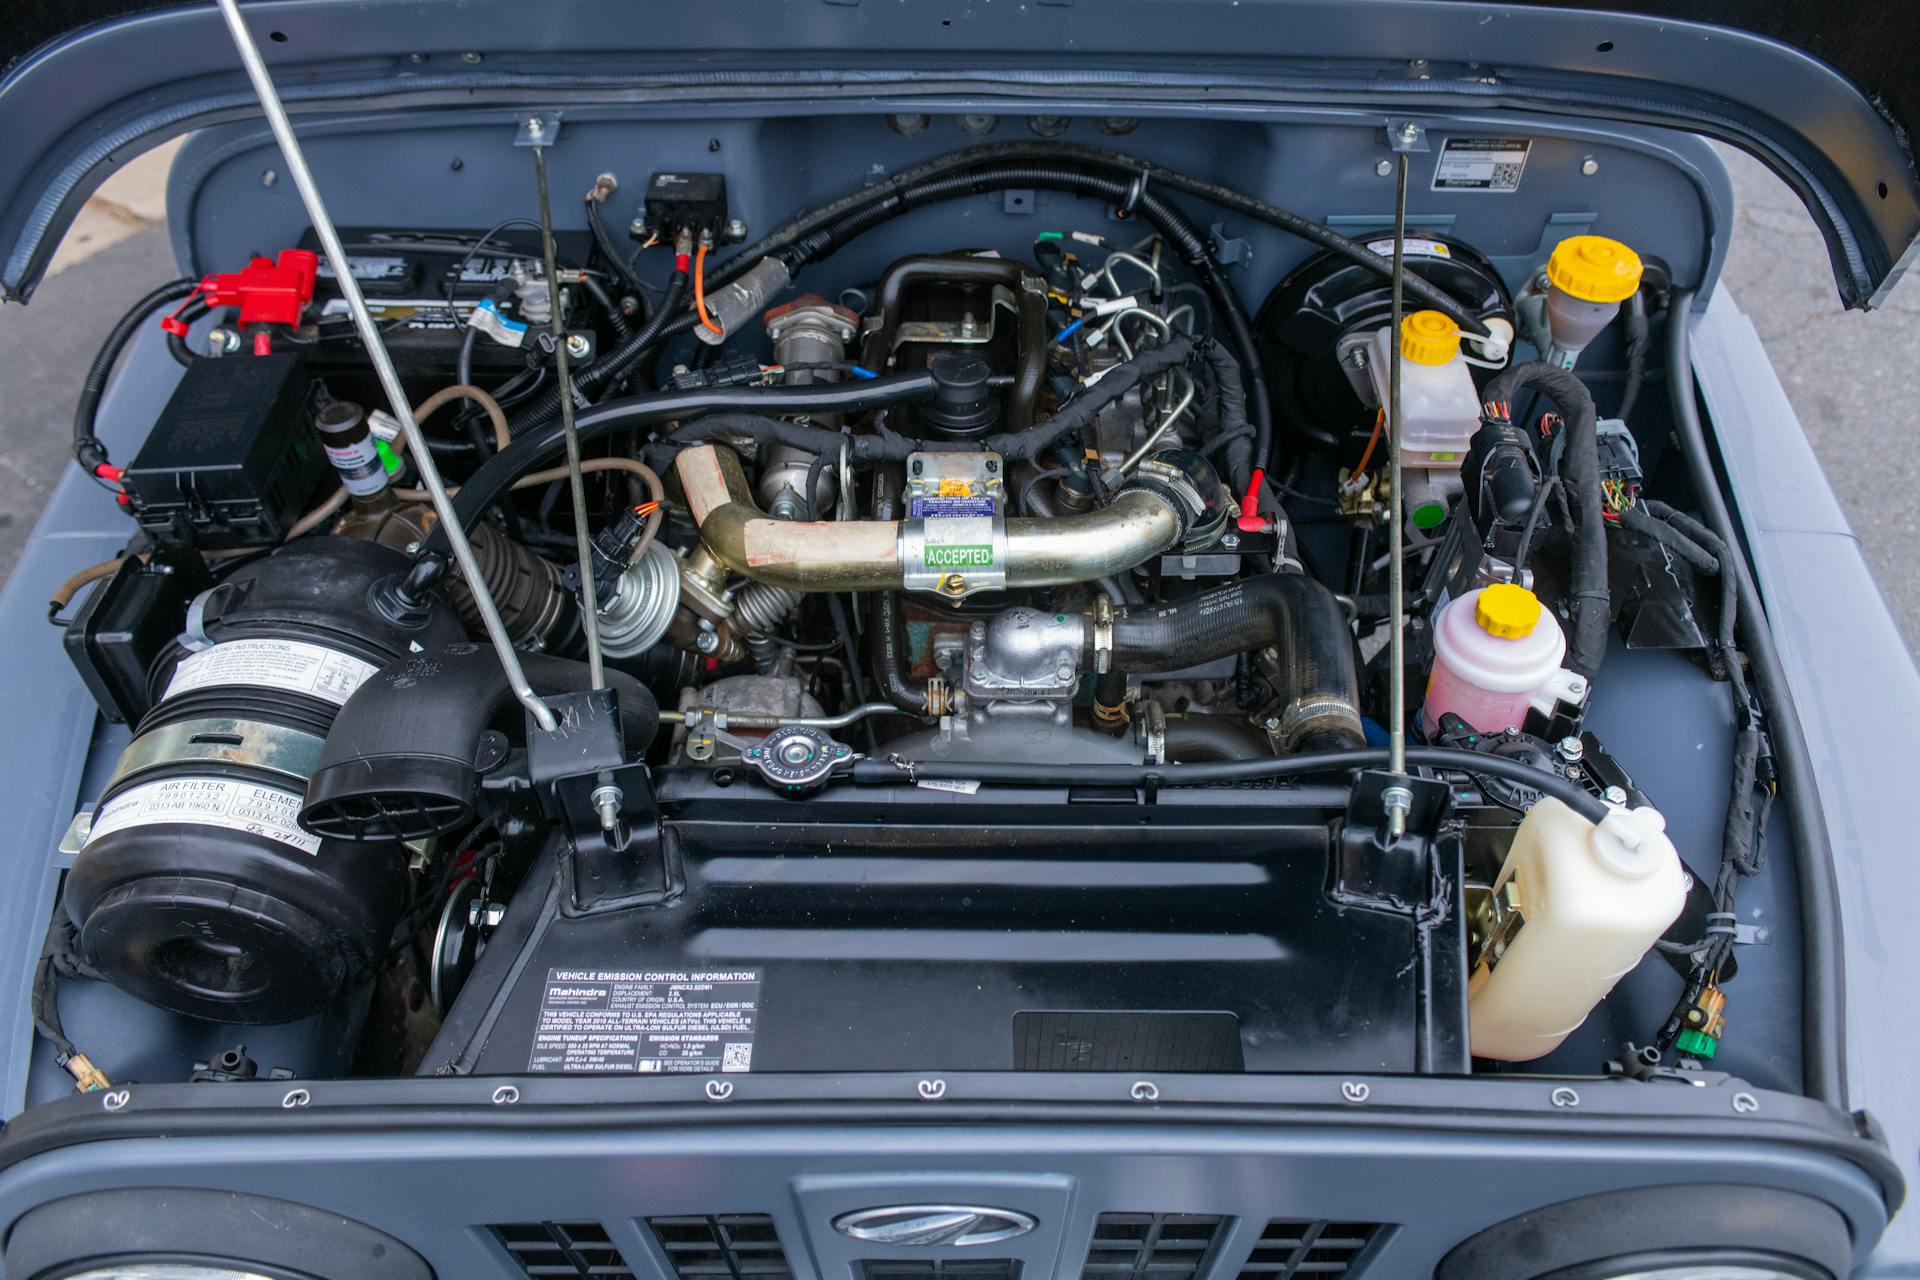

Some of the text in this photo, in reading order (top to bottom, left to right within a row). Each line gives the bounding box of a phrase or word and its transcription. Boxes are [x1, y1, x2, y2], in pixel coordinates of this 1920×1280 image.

[928, 548, 990, 564] ACCEPTED
[160, 782, 226, 791] AIR FILTER
[254, 789, 302, 809] ELEMEN
[239, 809, 262, 819] 0313
[264, 814, 277, 824] AC
[556, 972, 755, 980] VEHICLE EMISSION CONTROL INFORMATION
[549, 988, 606, 996] Mahindra
